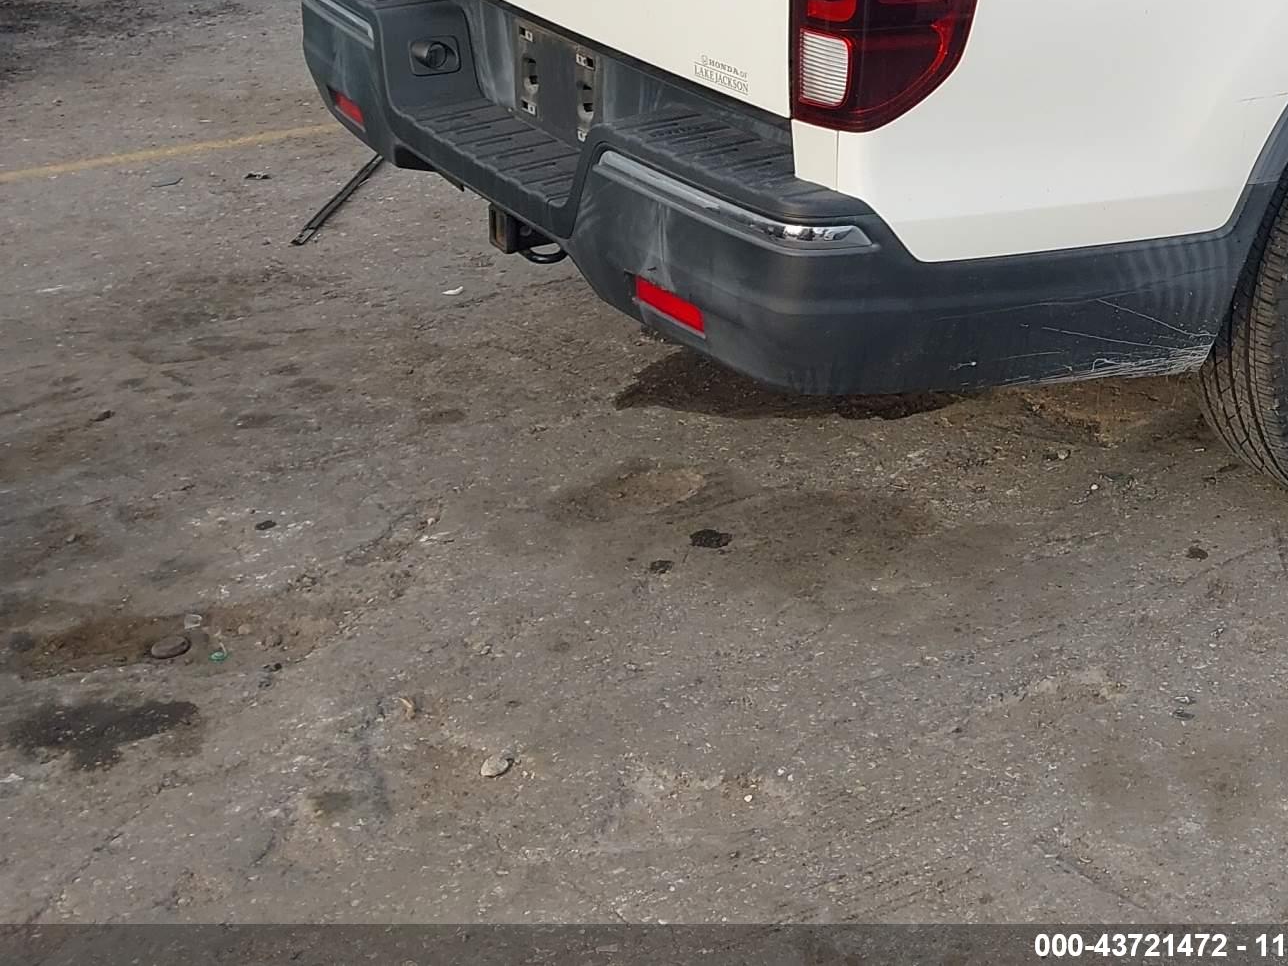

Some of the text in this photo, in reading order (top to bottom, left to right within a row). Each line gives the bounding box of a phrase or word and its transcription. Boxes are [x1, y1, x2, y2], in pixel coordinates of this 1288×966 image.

[694, 64, 749, 93] LAKE JACKSON
[709, 59, 739, 76] HONDA
